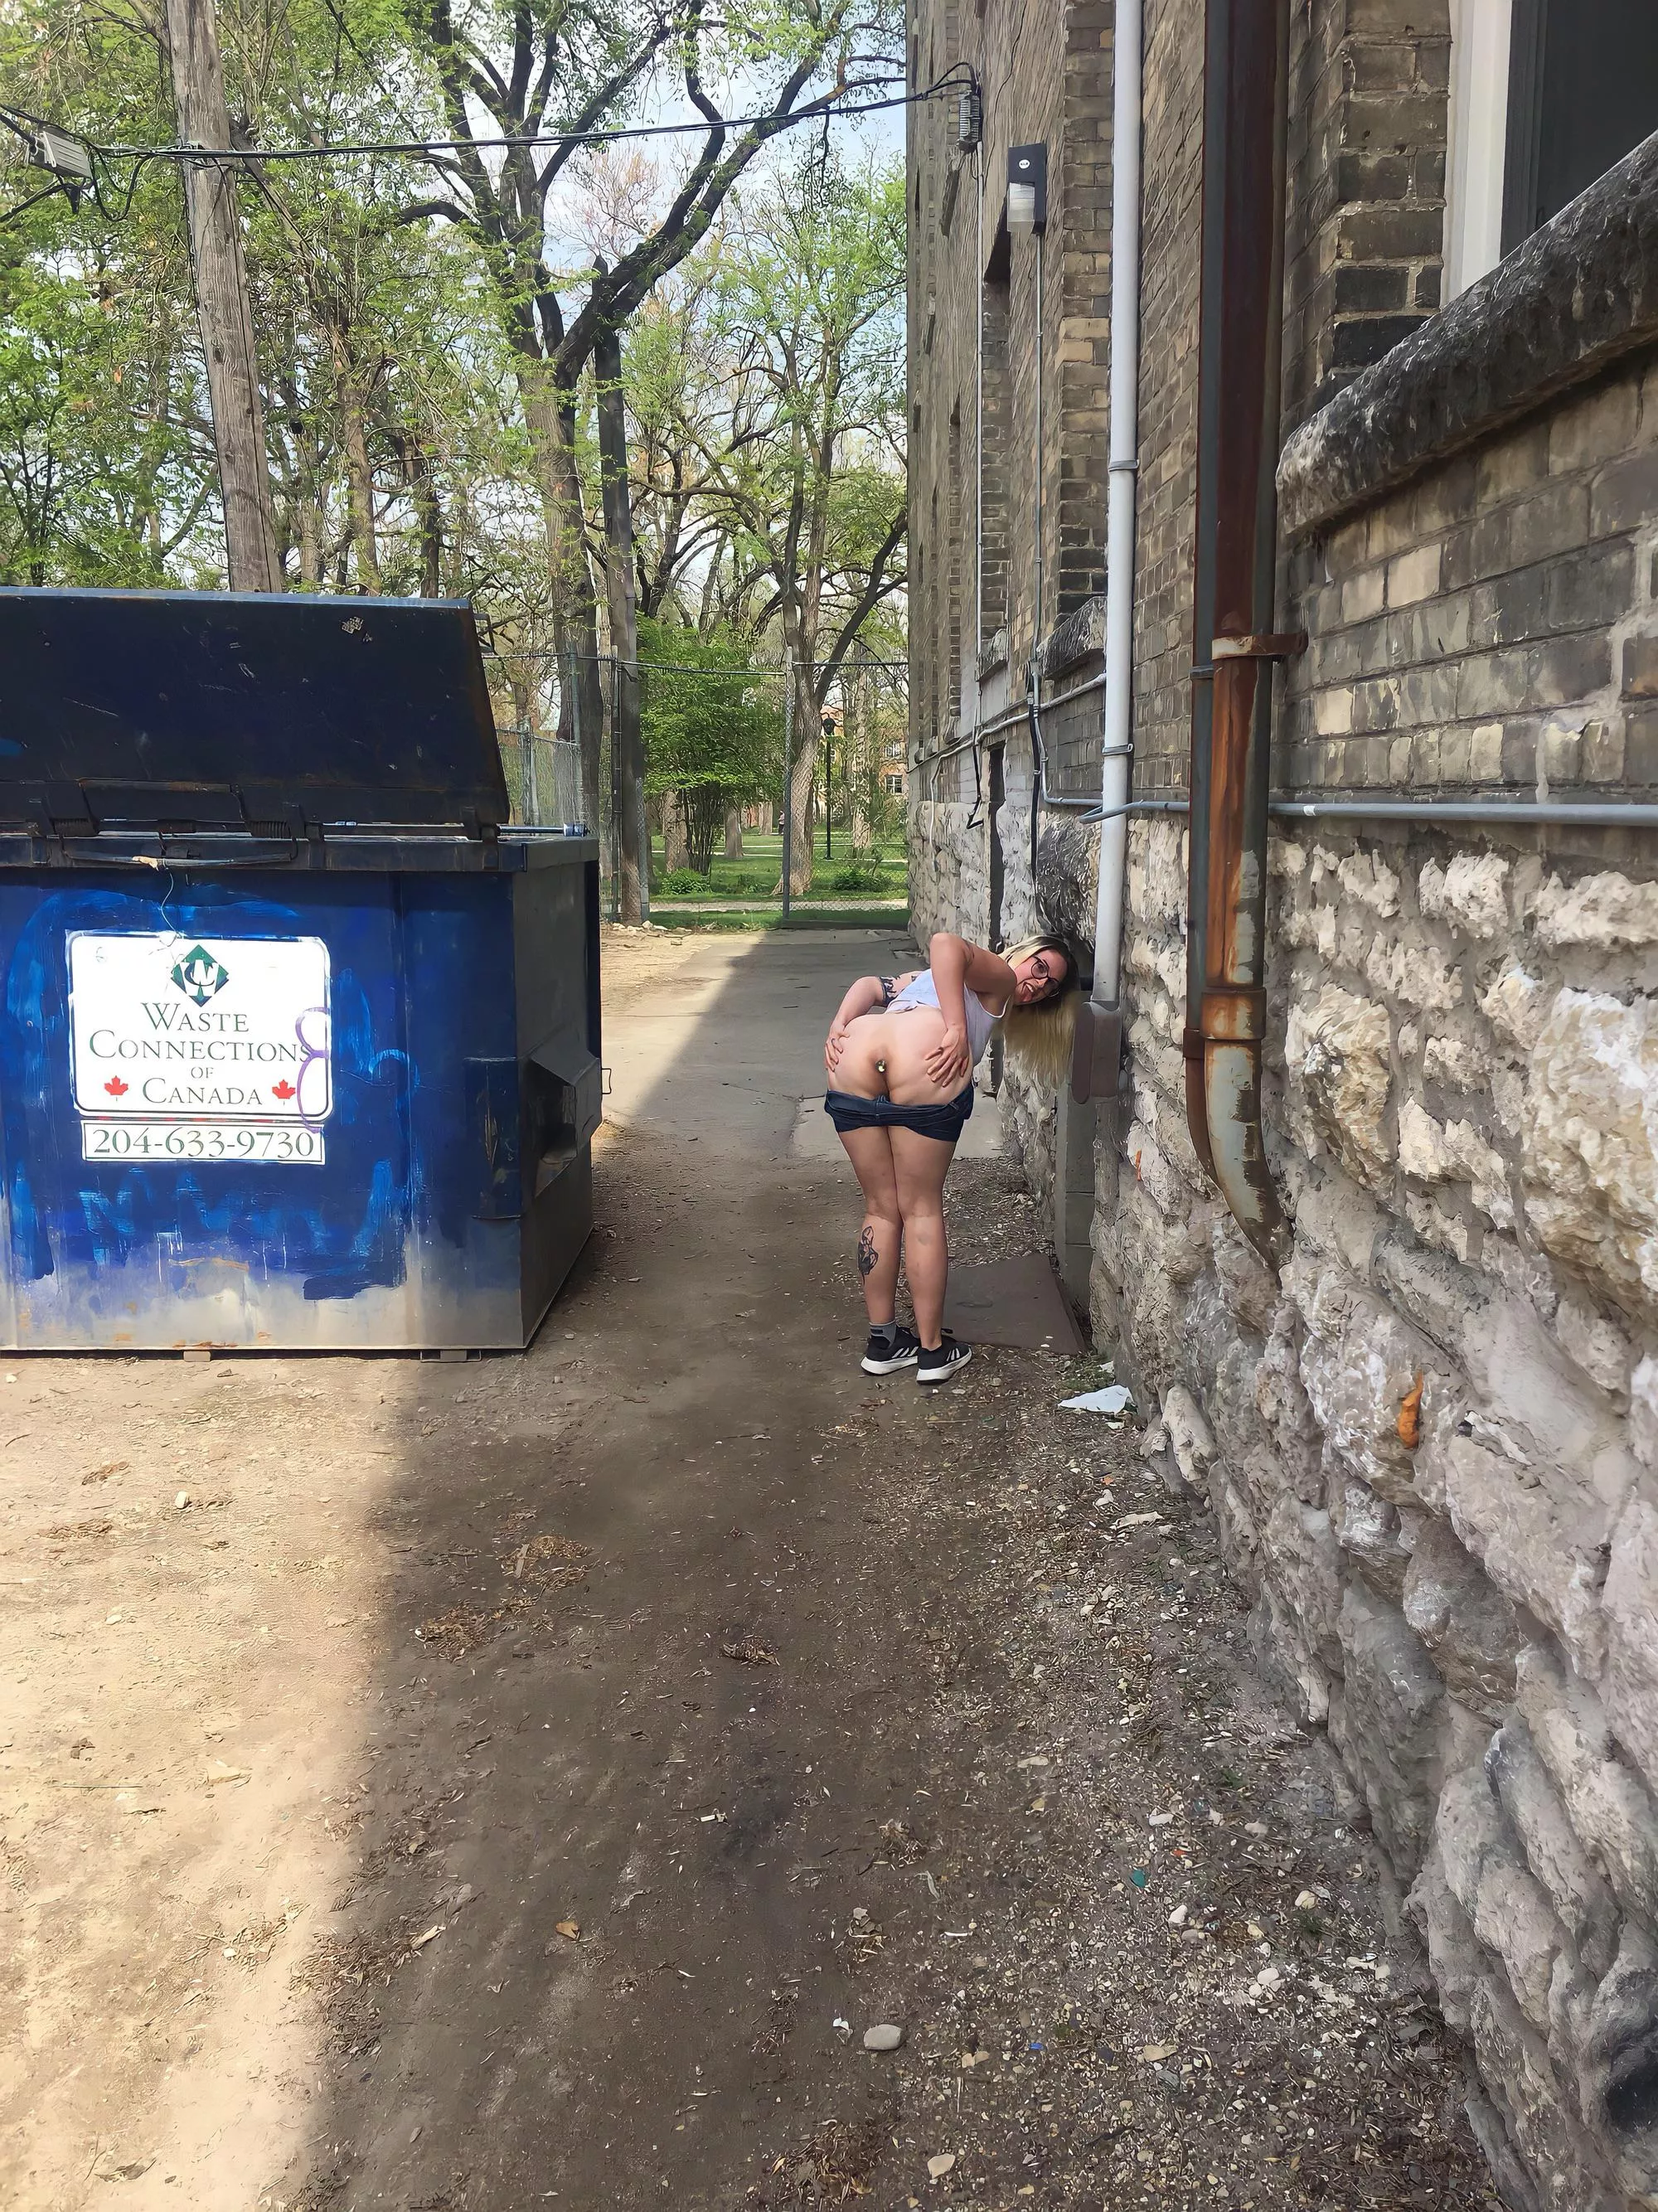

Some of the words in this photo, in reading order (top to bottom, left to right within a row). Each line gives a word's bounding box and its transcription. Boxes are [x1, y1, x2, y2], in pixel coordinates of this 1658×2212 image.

[140, 1002, 250, 1032] WASTE
[89, 1029, 311, 1062] CONNECTIONS
[143, 1077, 263, 1105] CANADA
[93, 1126, 314, 1158] 204-633-9730
